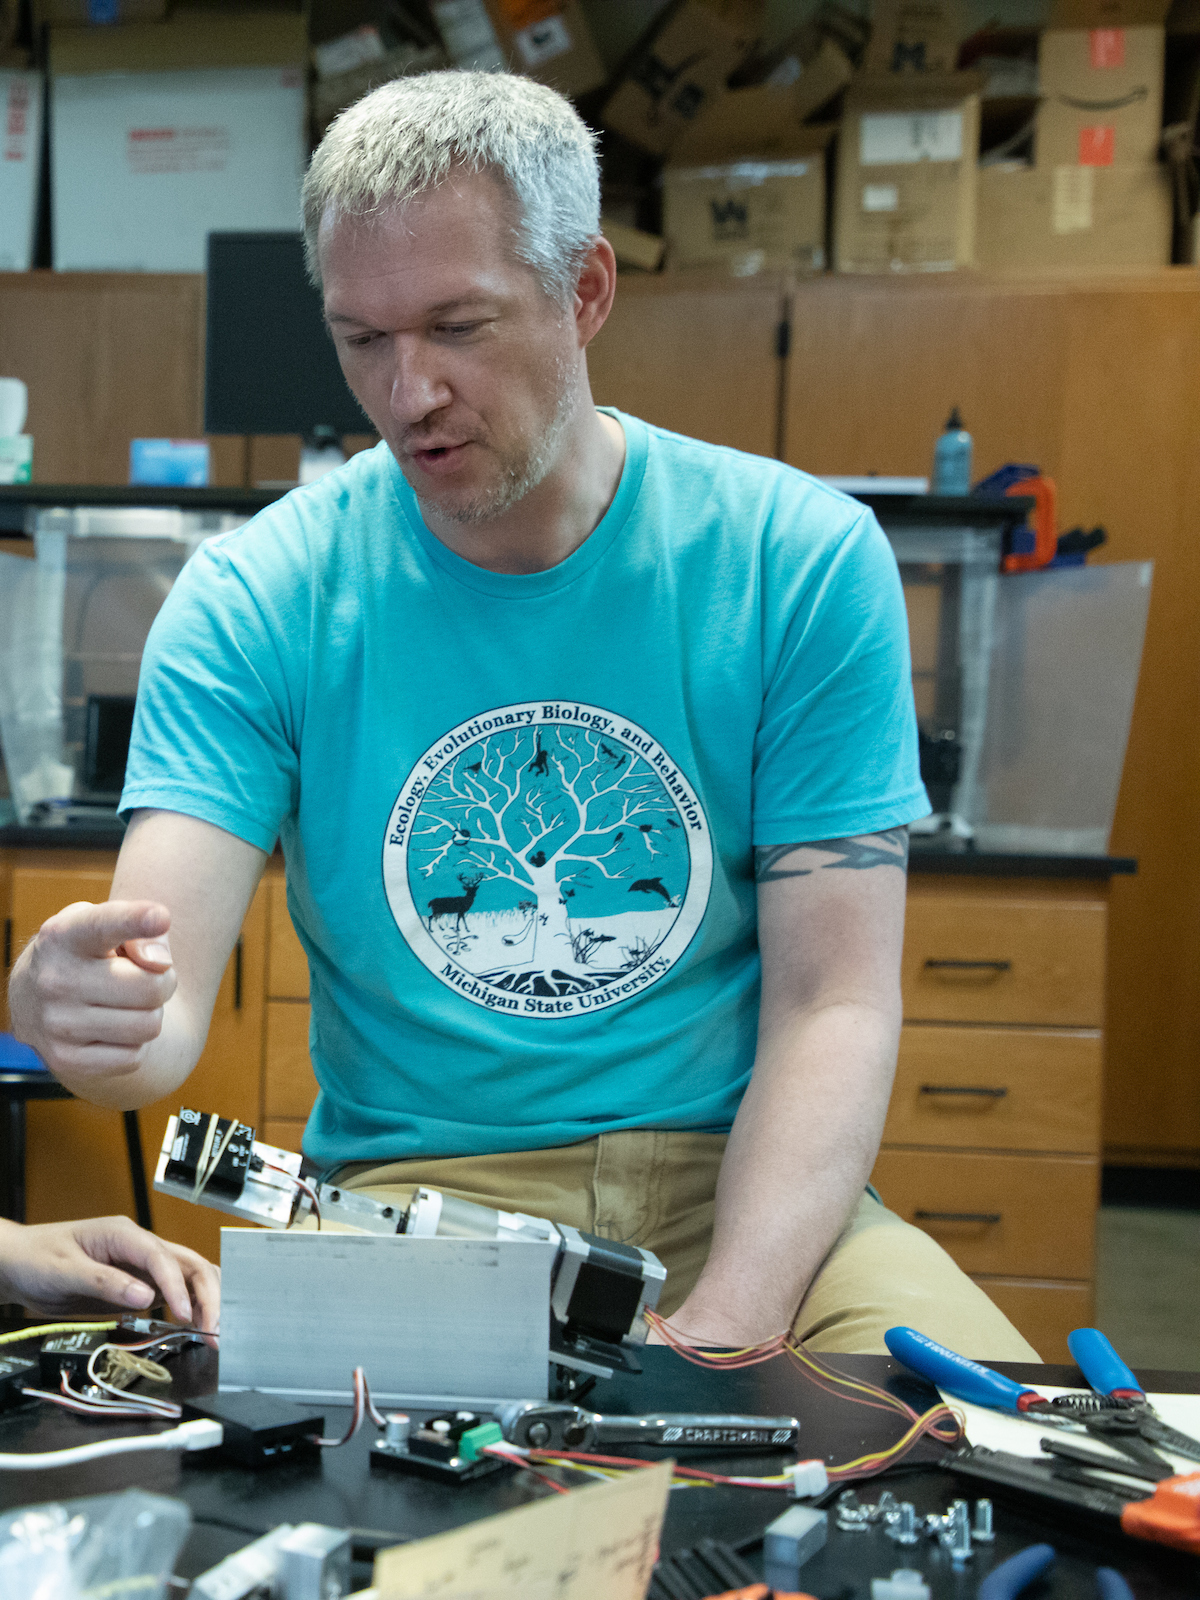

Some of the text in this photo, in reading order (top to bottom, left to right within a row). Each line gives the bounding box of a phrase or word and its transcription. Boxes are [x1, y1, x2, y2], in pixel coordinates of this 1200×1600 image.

[390, 704, 703, 847] Ecology, Evolutionary Biology, and Behavior
[439, 962, 519, 1010] Michigan
[523, 994, 574, 1014] State
[685, 1428, 769, 1442] CRAFTSMAN
